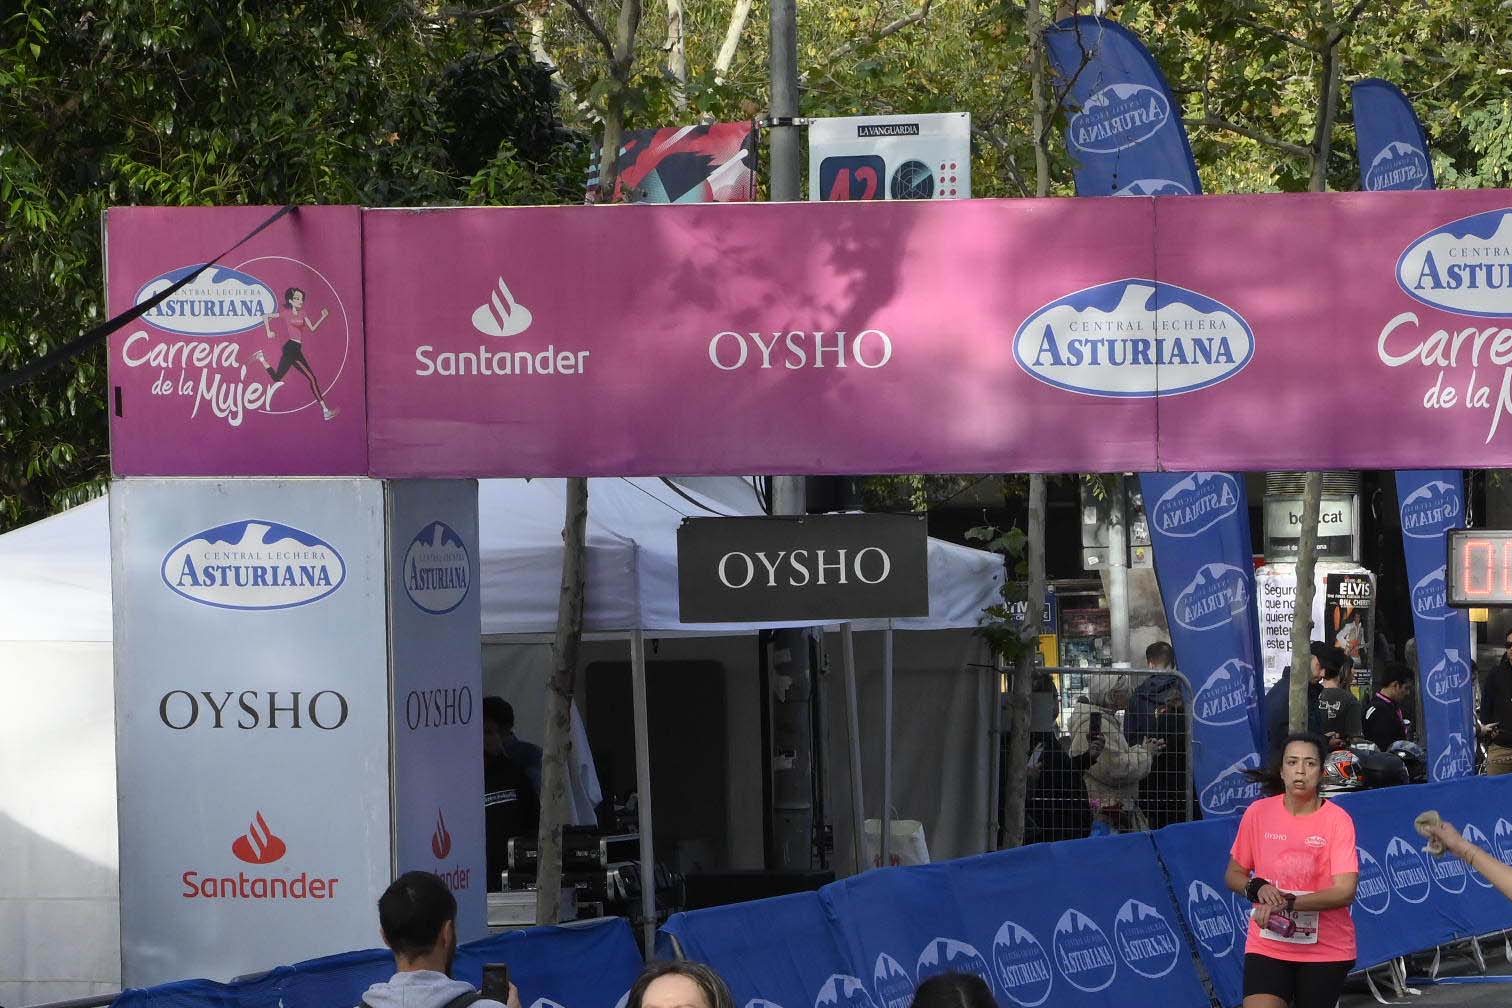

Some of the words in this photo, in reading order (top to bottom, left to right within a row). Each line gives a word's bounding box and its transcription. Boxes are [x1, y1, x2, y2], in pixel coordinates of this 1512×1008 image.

[869, 125, 918, 136] VANGUARDIA
[145, 290, 266, 317] ASTURIANA
[173, 288, 212, 296] ENTRAL
[216, 288, 261, 296] LECHERA
[1069, 320, 1145, 331] CENTRAL
[1152, 318, 1228, 331] LECHERA
[122, 331, 240, 368] Carrera
[415, 344, 590, 377] Santander
[708, 329, 893, 371] OYSHO
[1032, 322, 1237, 367] ASTURIANA
[151, 369, 174, 396] de
[178, 369, 194, 396] la
[191, 364, 285, 427] Mujer
[1423, 371, 1457, 410] de
[1465, 371, 1490, 410] la
[1289, 510, 1343, 525] b.cat
[176, 553, 334, 588] ASTURIANA
[204, 552, 262, 561] CENTRAL
[268, 551, 327, 560] LECHERA
[717, 546, 892, 589] OYSHO
[408, 556, 467, 592] ASTURIANA
[1340, 582, 1370, 595] ELVIS
[1266, 599, 1281, 610] que
[1266, 638, 1285, 650] este
[158, 689, 350, 731] OYSHO
[406, 684, 473, 732] OYSHO
[182, 871, 339, 900] Santander
